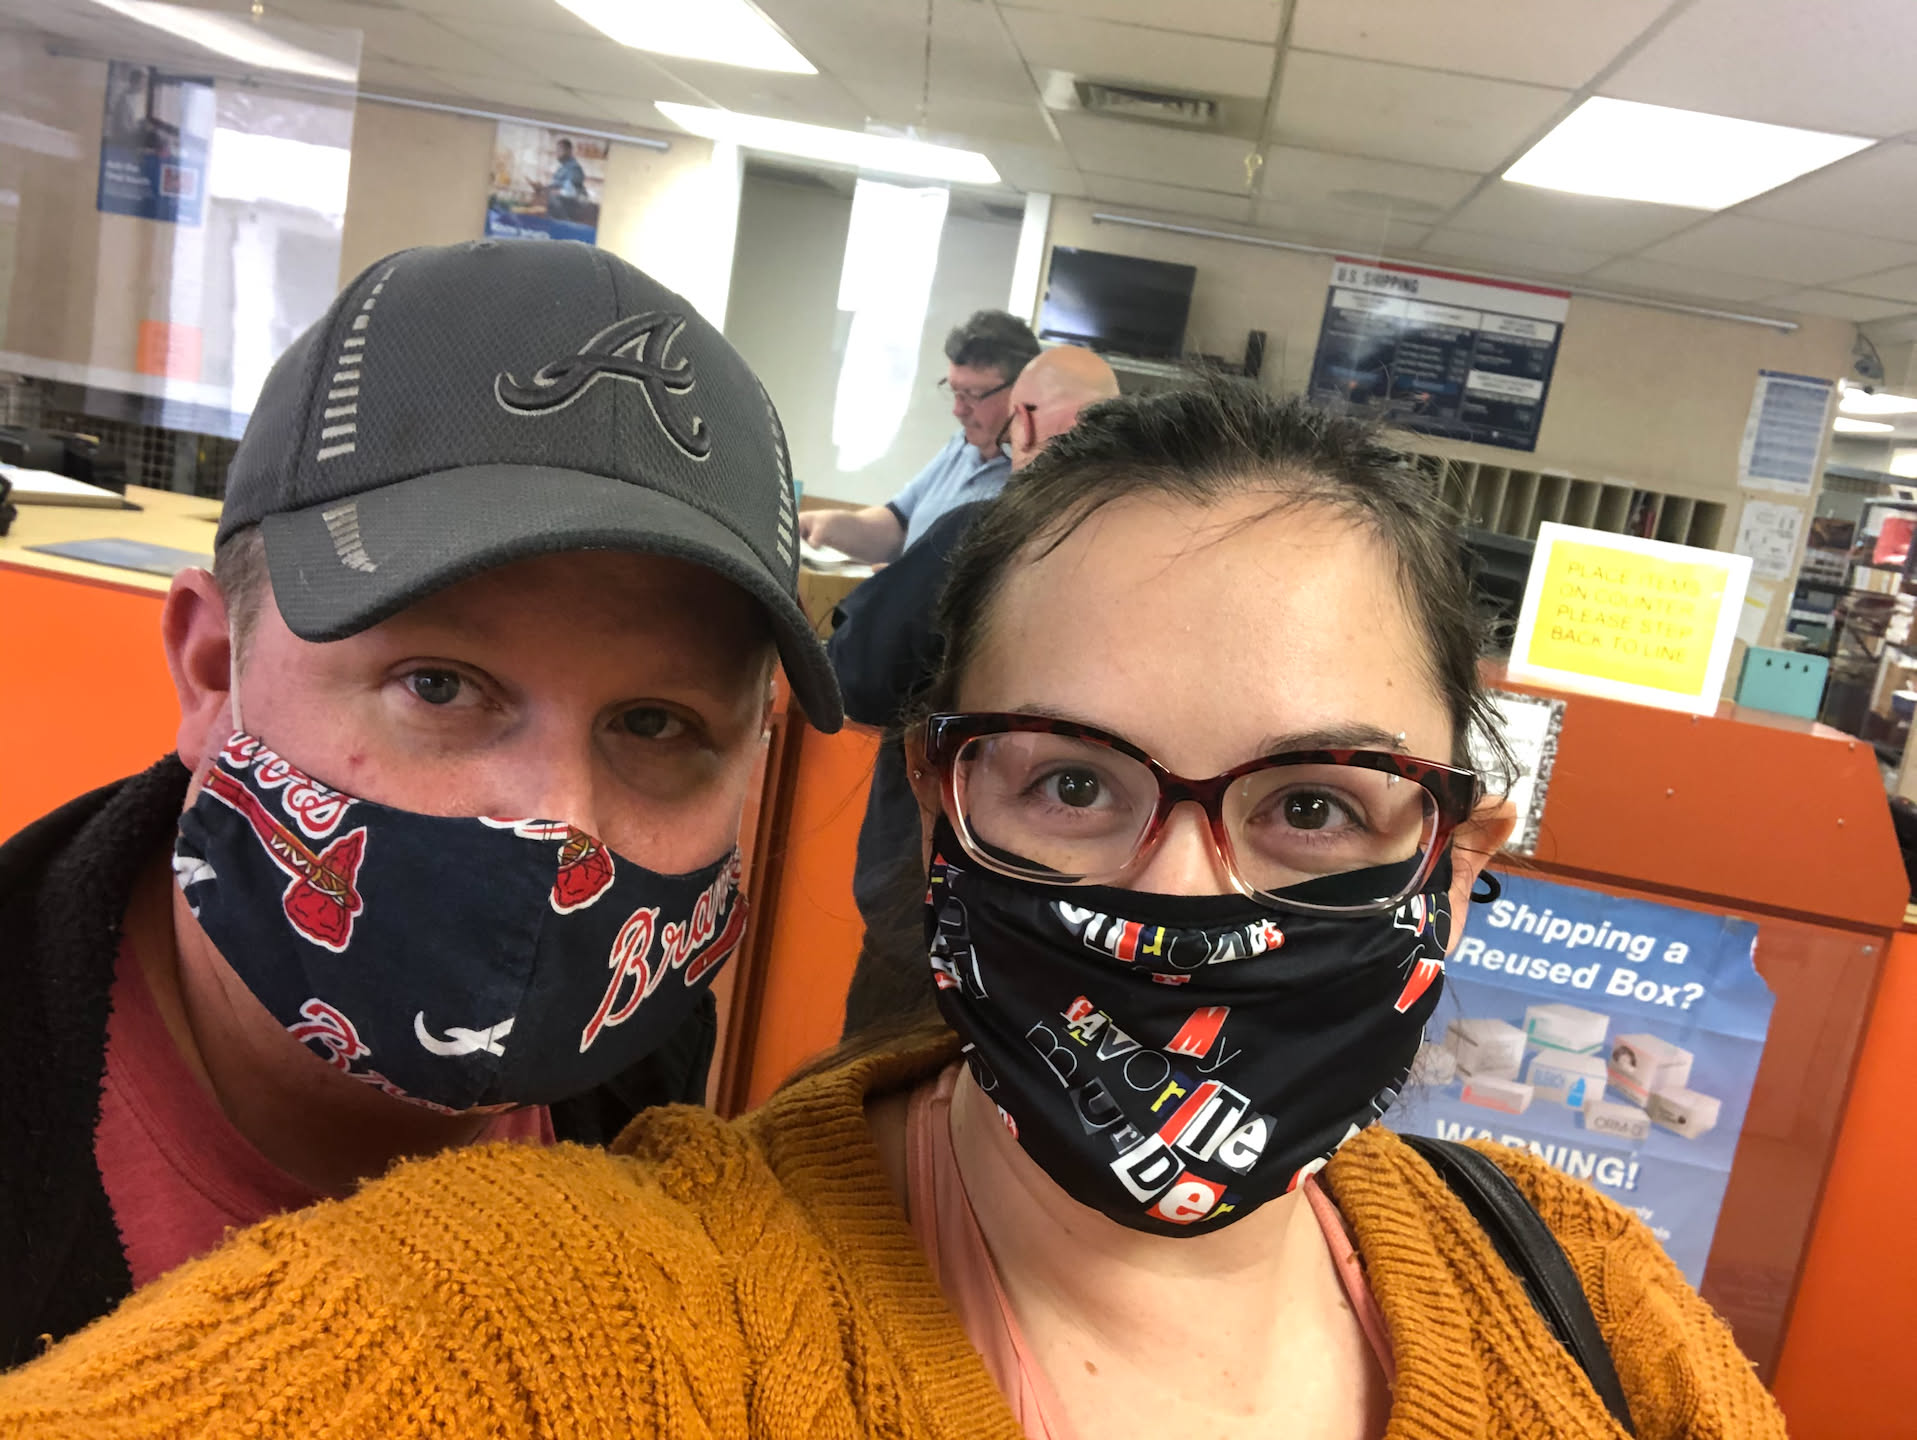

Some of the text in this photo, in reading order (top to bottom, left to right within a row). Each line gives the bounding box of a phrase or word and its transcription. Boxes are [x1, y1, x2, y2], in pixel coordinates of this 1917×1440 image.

[1362, 270, 1419, 294] SHIPPING
[1568, 560, 1630, 585] PLACE
[1557, 604, 1693, 640] PLEASE STEP
[1560, 582, 1694, 617] ON COUNTER
[1551, 625, 1687, 664] BACK TO LINE
[579, 850, 741, 1053] Brav
[1487, 898, 1656, 963] Shipping
[1663, 940, 1690, 965] a
[1453, 936, 1705, 1011] Reused Box?
[1163, 1006, 1242, 1074] My
[1436, 1119, 1639, 1190] WNING!
